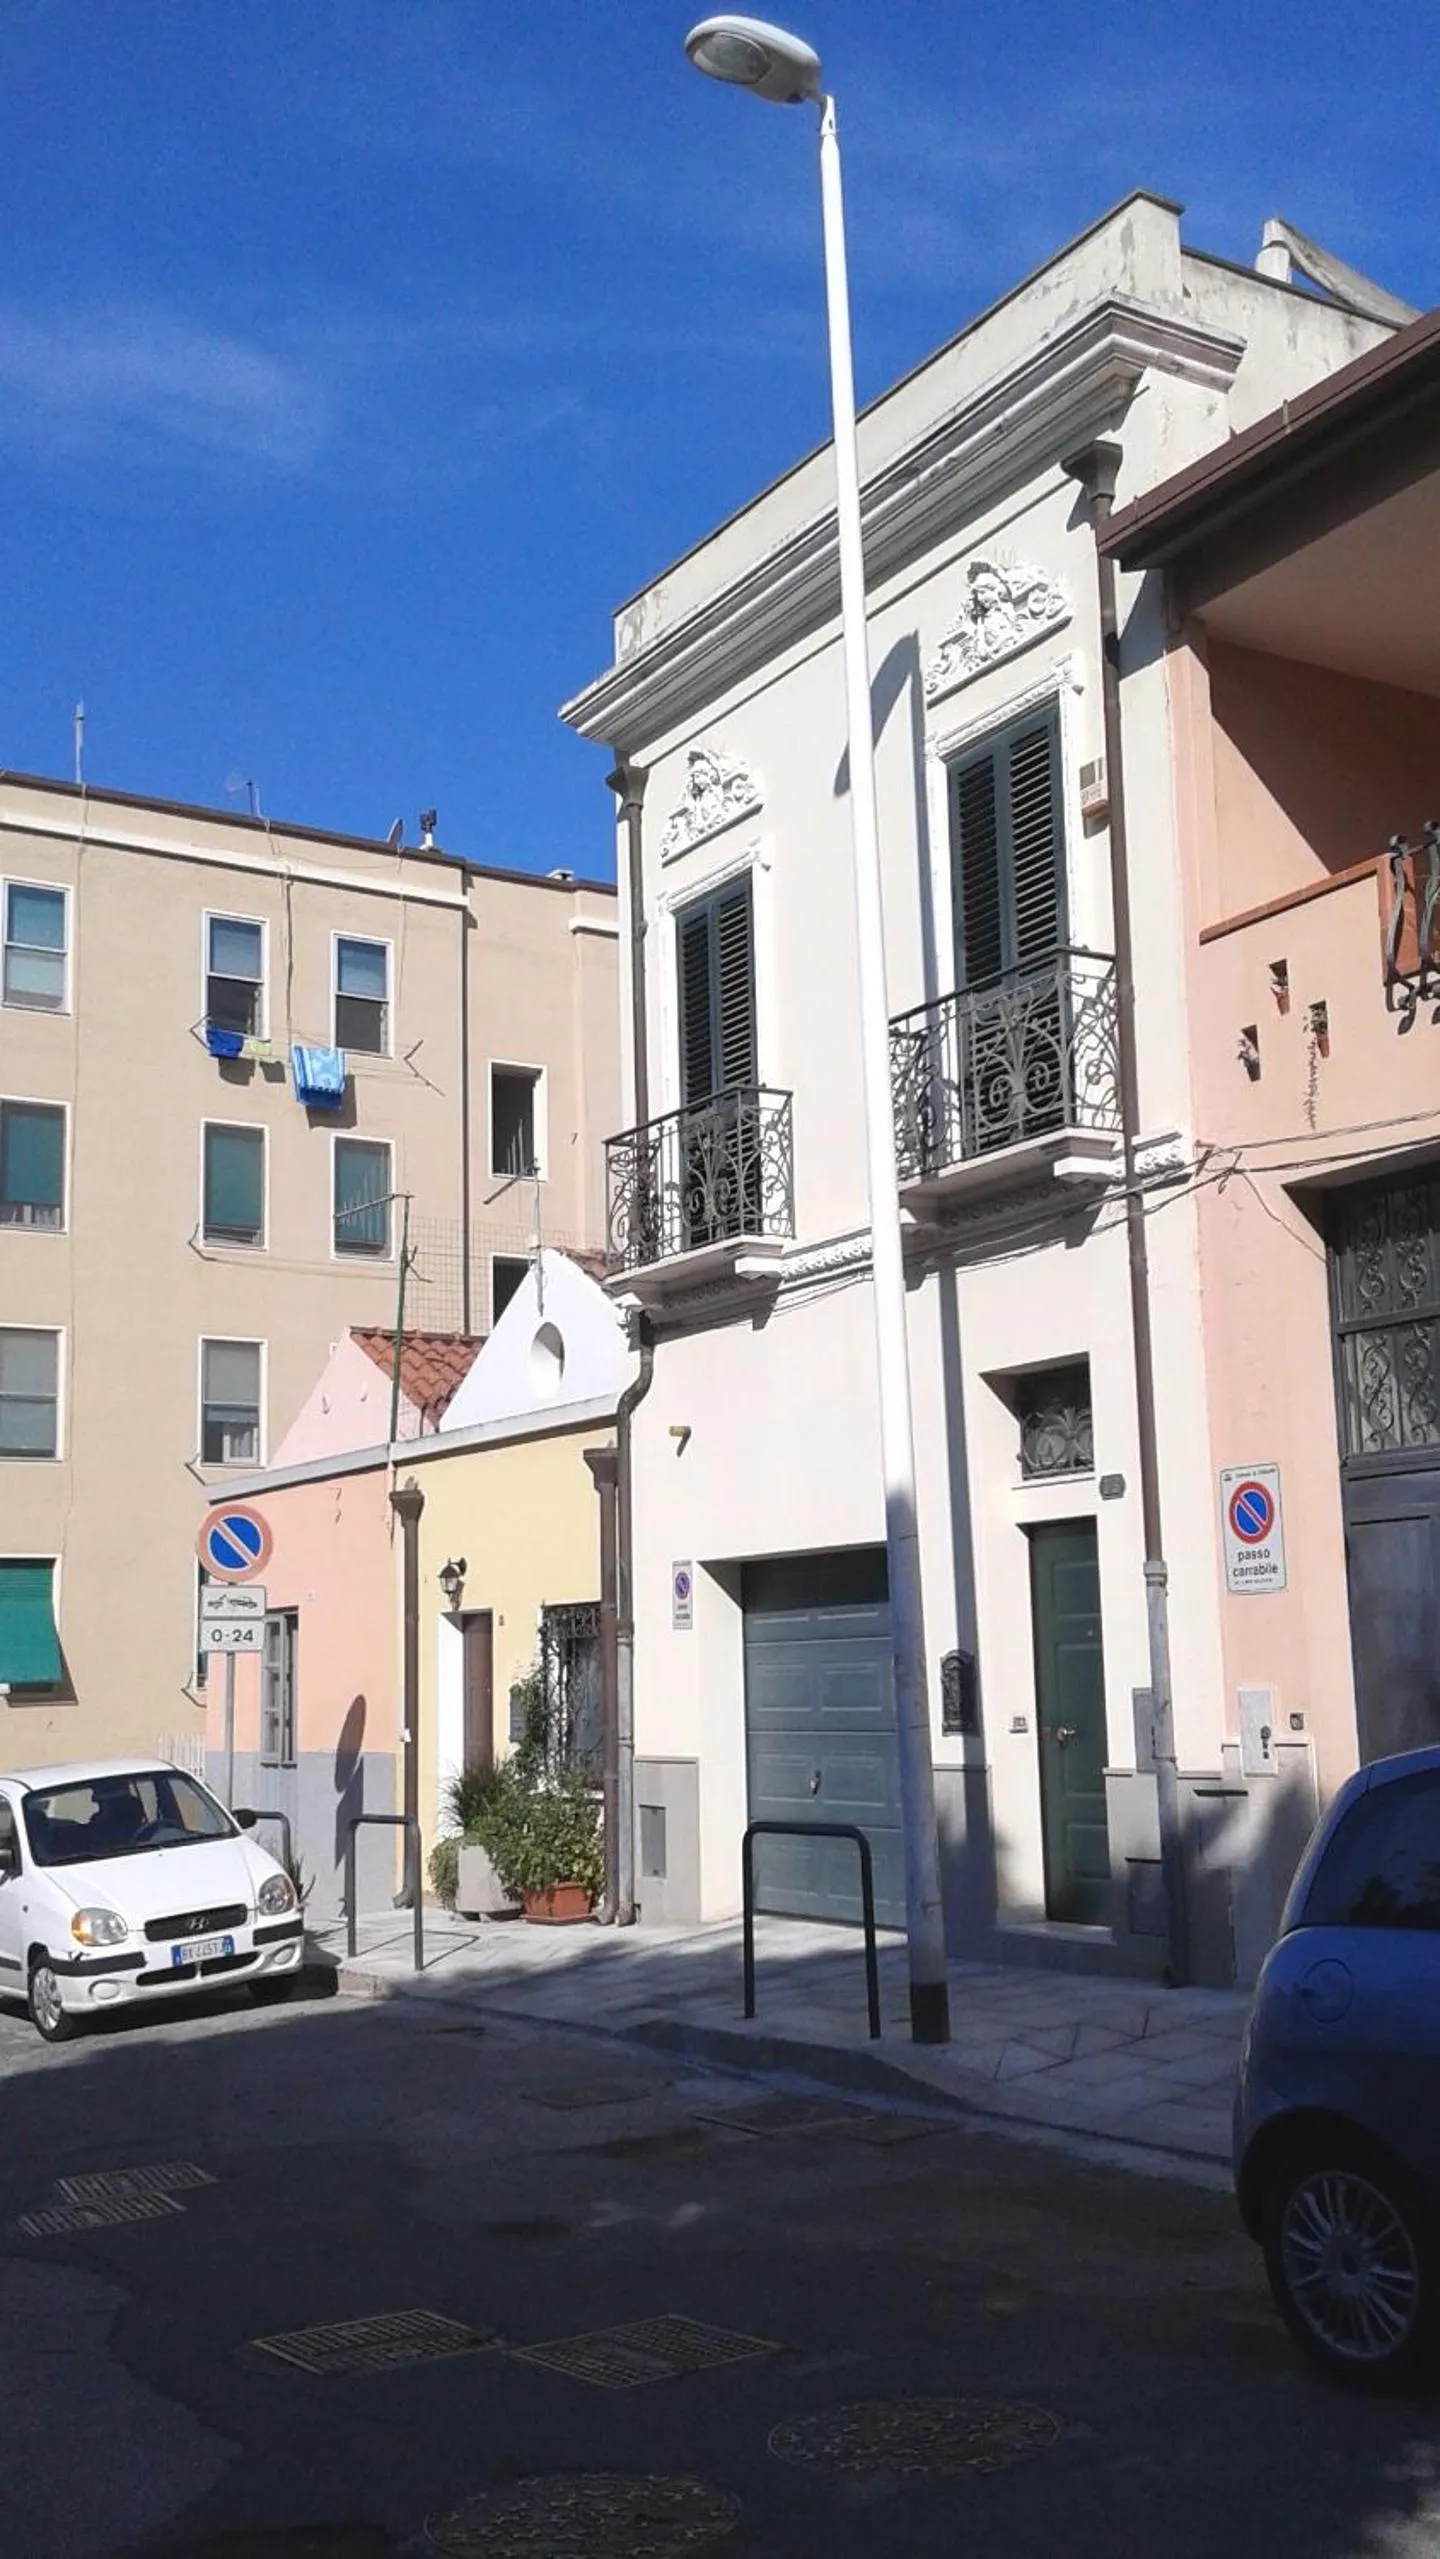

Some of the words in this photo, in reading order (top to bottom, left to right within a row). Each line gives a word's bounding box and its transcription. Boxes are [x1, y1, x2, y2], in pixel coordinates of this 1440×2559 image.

[1237, 1548, 1270, 1563] passo
[1233, 1562, 1279, 1577] carrabile
[211, 1628, 253, 1642] 0-24
